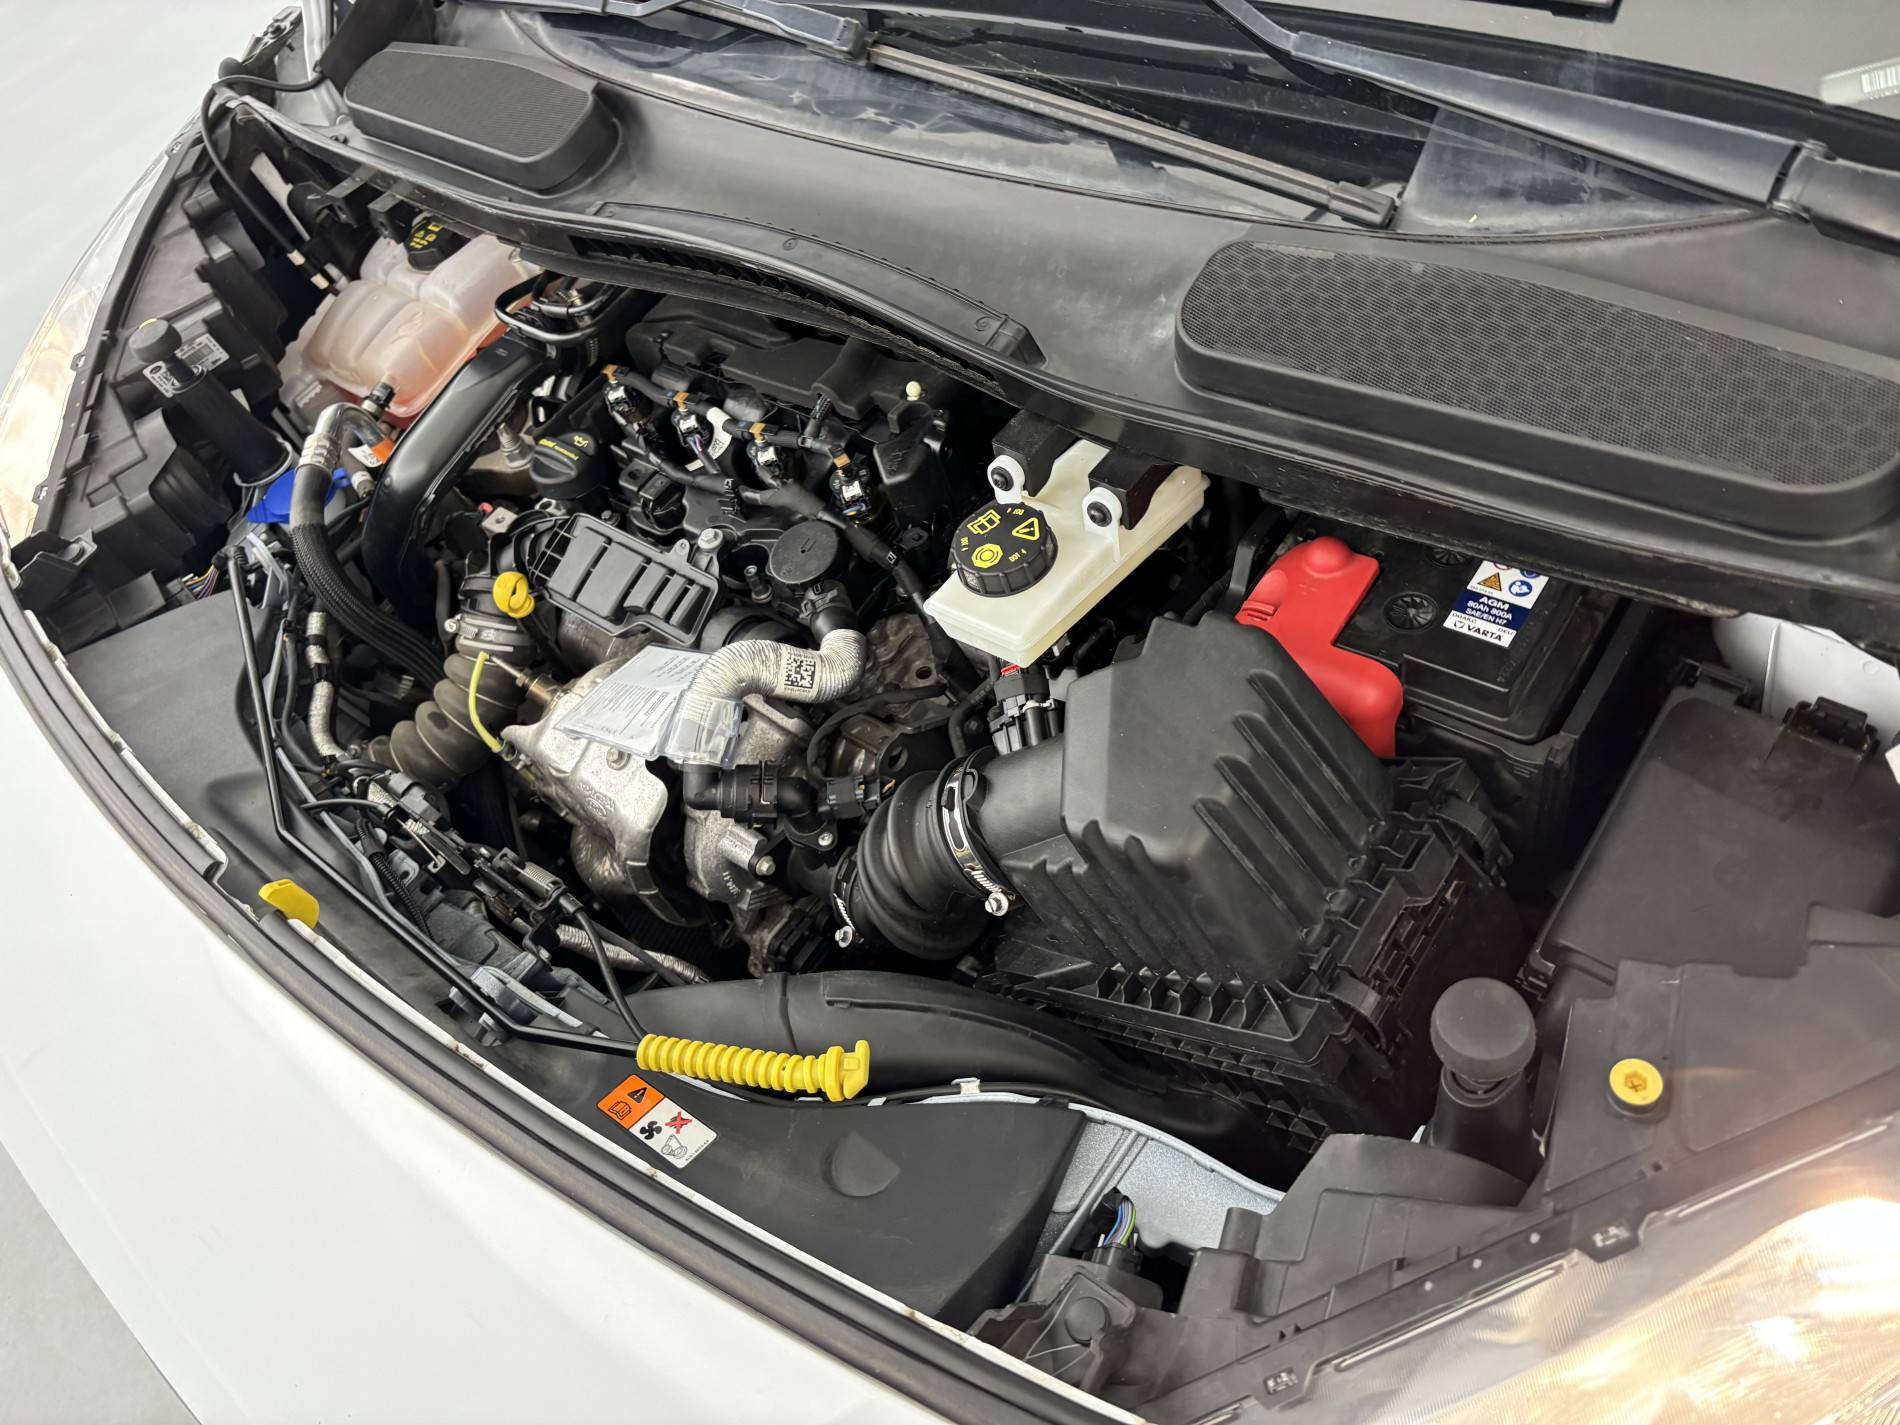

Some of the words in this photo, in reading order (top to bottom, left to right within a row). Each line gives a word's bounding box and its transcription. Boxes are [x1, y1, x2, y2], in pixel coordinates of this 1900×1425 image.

[1467, 600, 1490, 613] 80Ah
[1490, 608, 1513, 621] 800A
[1479, 596, 1510, 611] AGM
[1465, 608, 1496, 622] SAE/EN
[1495, 616, 1507, 626] H7
[1467, 624, 1503, 642] VARTA
